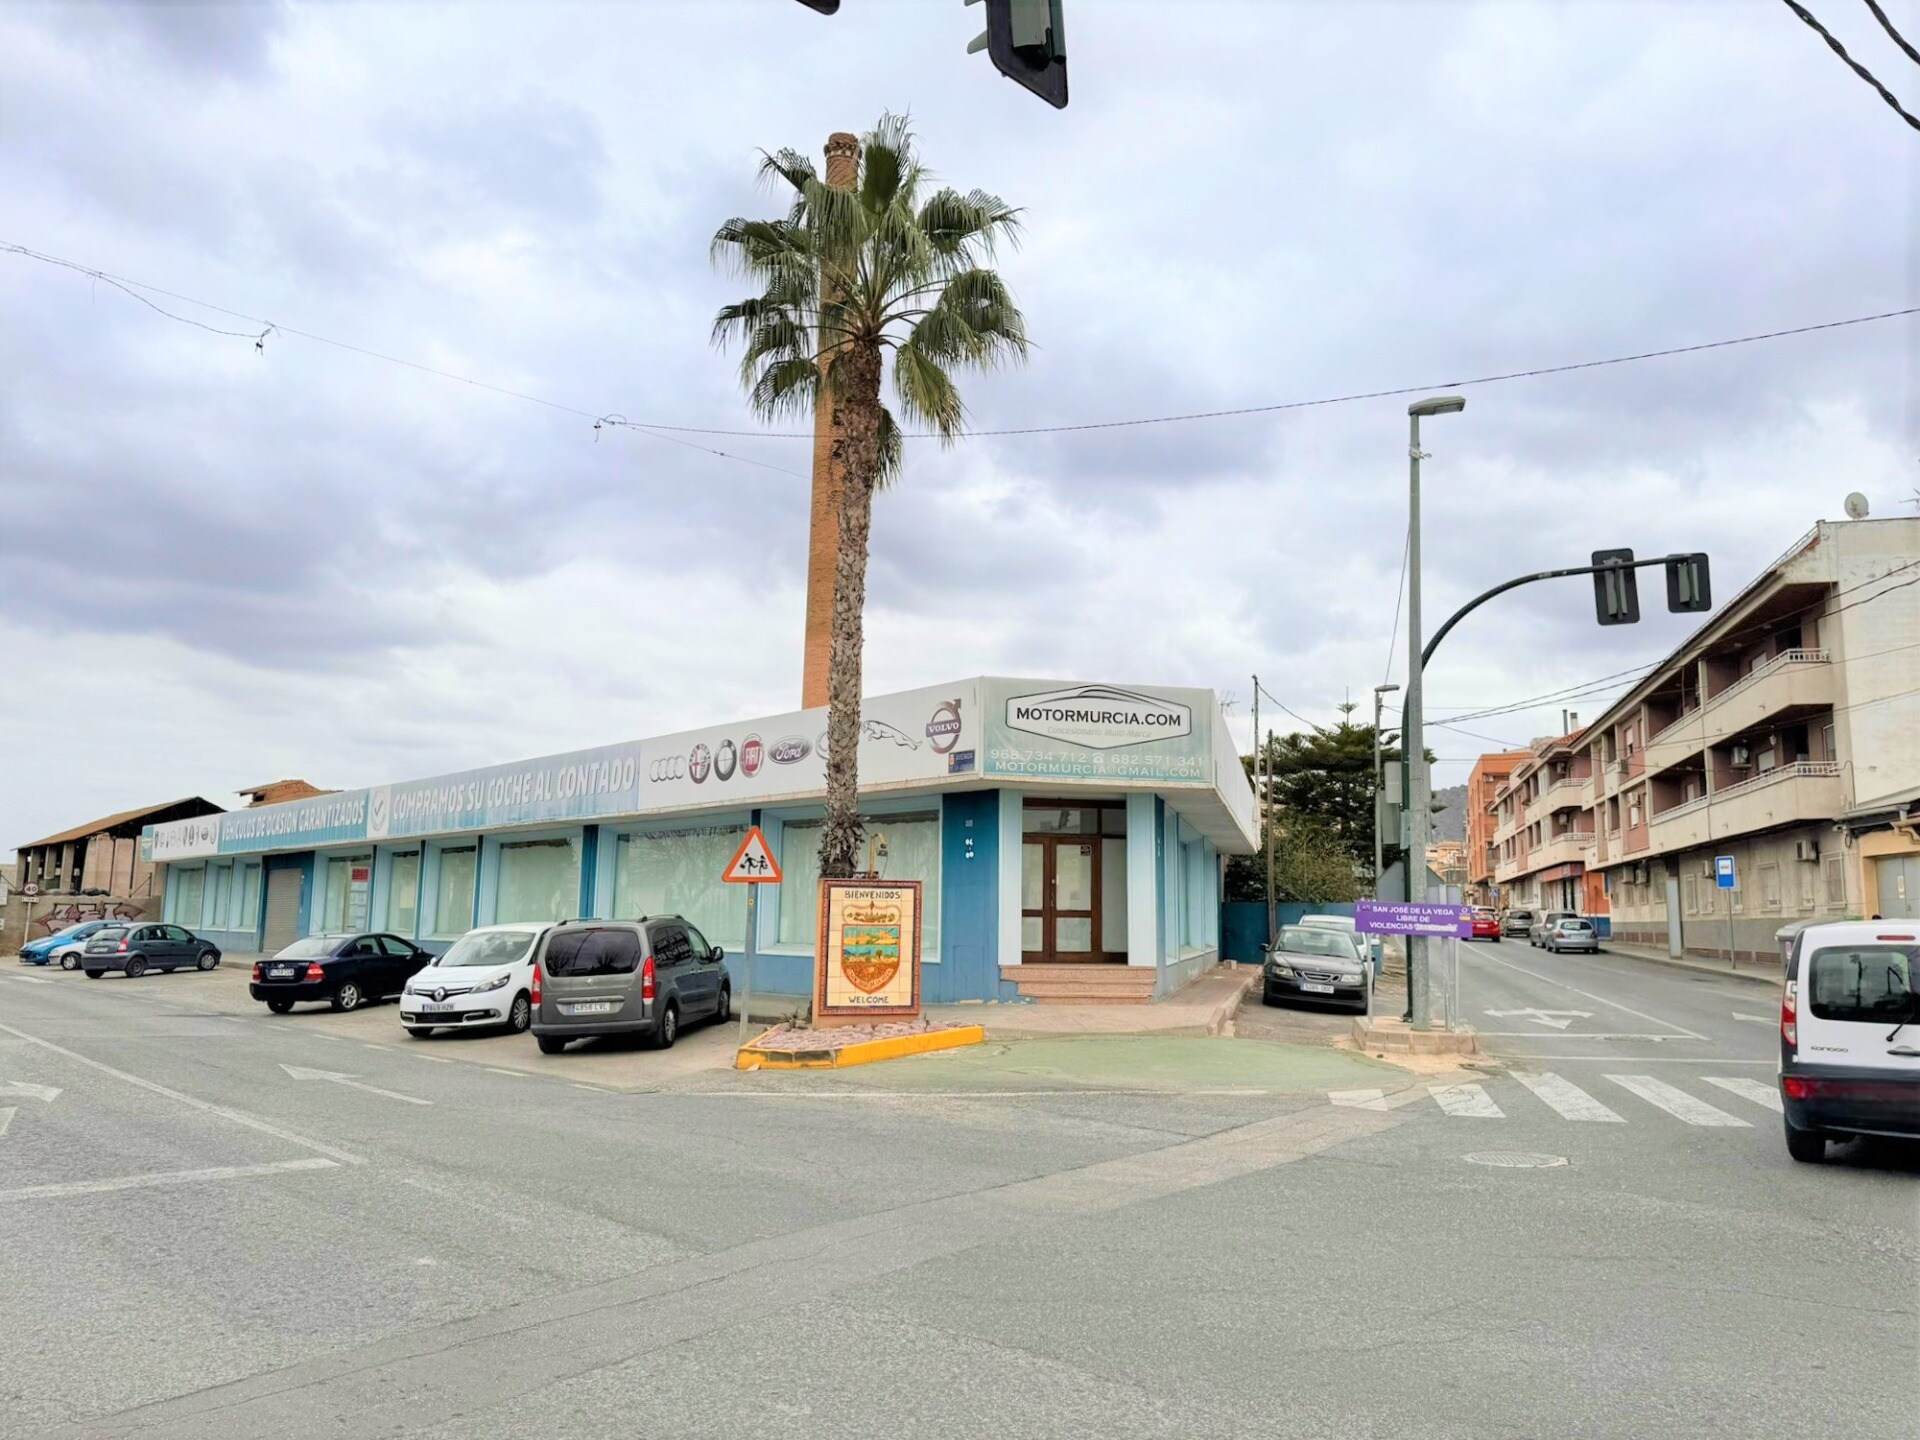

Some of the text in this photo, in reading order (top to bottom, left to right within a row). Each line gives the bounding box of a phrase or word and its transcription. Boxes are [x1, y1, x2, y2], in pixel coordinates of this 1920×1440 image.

[1016, 707, 1181, 726] MOTORMURCIA.COM
[929, 722, 959, 733] VOLVO
[776, 742, 803, 760] Ford
[990, 749, 1203, 766] 968 734 712 682 571 341
[995, 761, 1200, 777] MOTORMURCIA@GMAIL.COM
[392, 756, 637, 820] COMPRAMOS SU COCHE AL CONTADO
[256, 816, 266, 838] DE
[299, 800, 365, 831] GARANTIZADOS
[844, 890, 901, 899] BIENVENIDOS
[1373, 905, 1388, 913] SAN
[1389, 906, 1409, 914] JOSÉ
[1433, 908, 1454, 916] VEGA
[1369, 922, 1414, 930] VIOLENCIAS
[848, 996, 889, 1004] WELCOME
